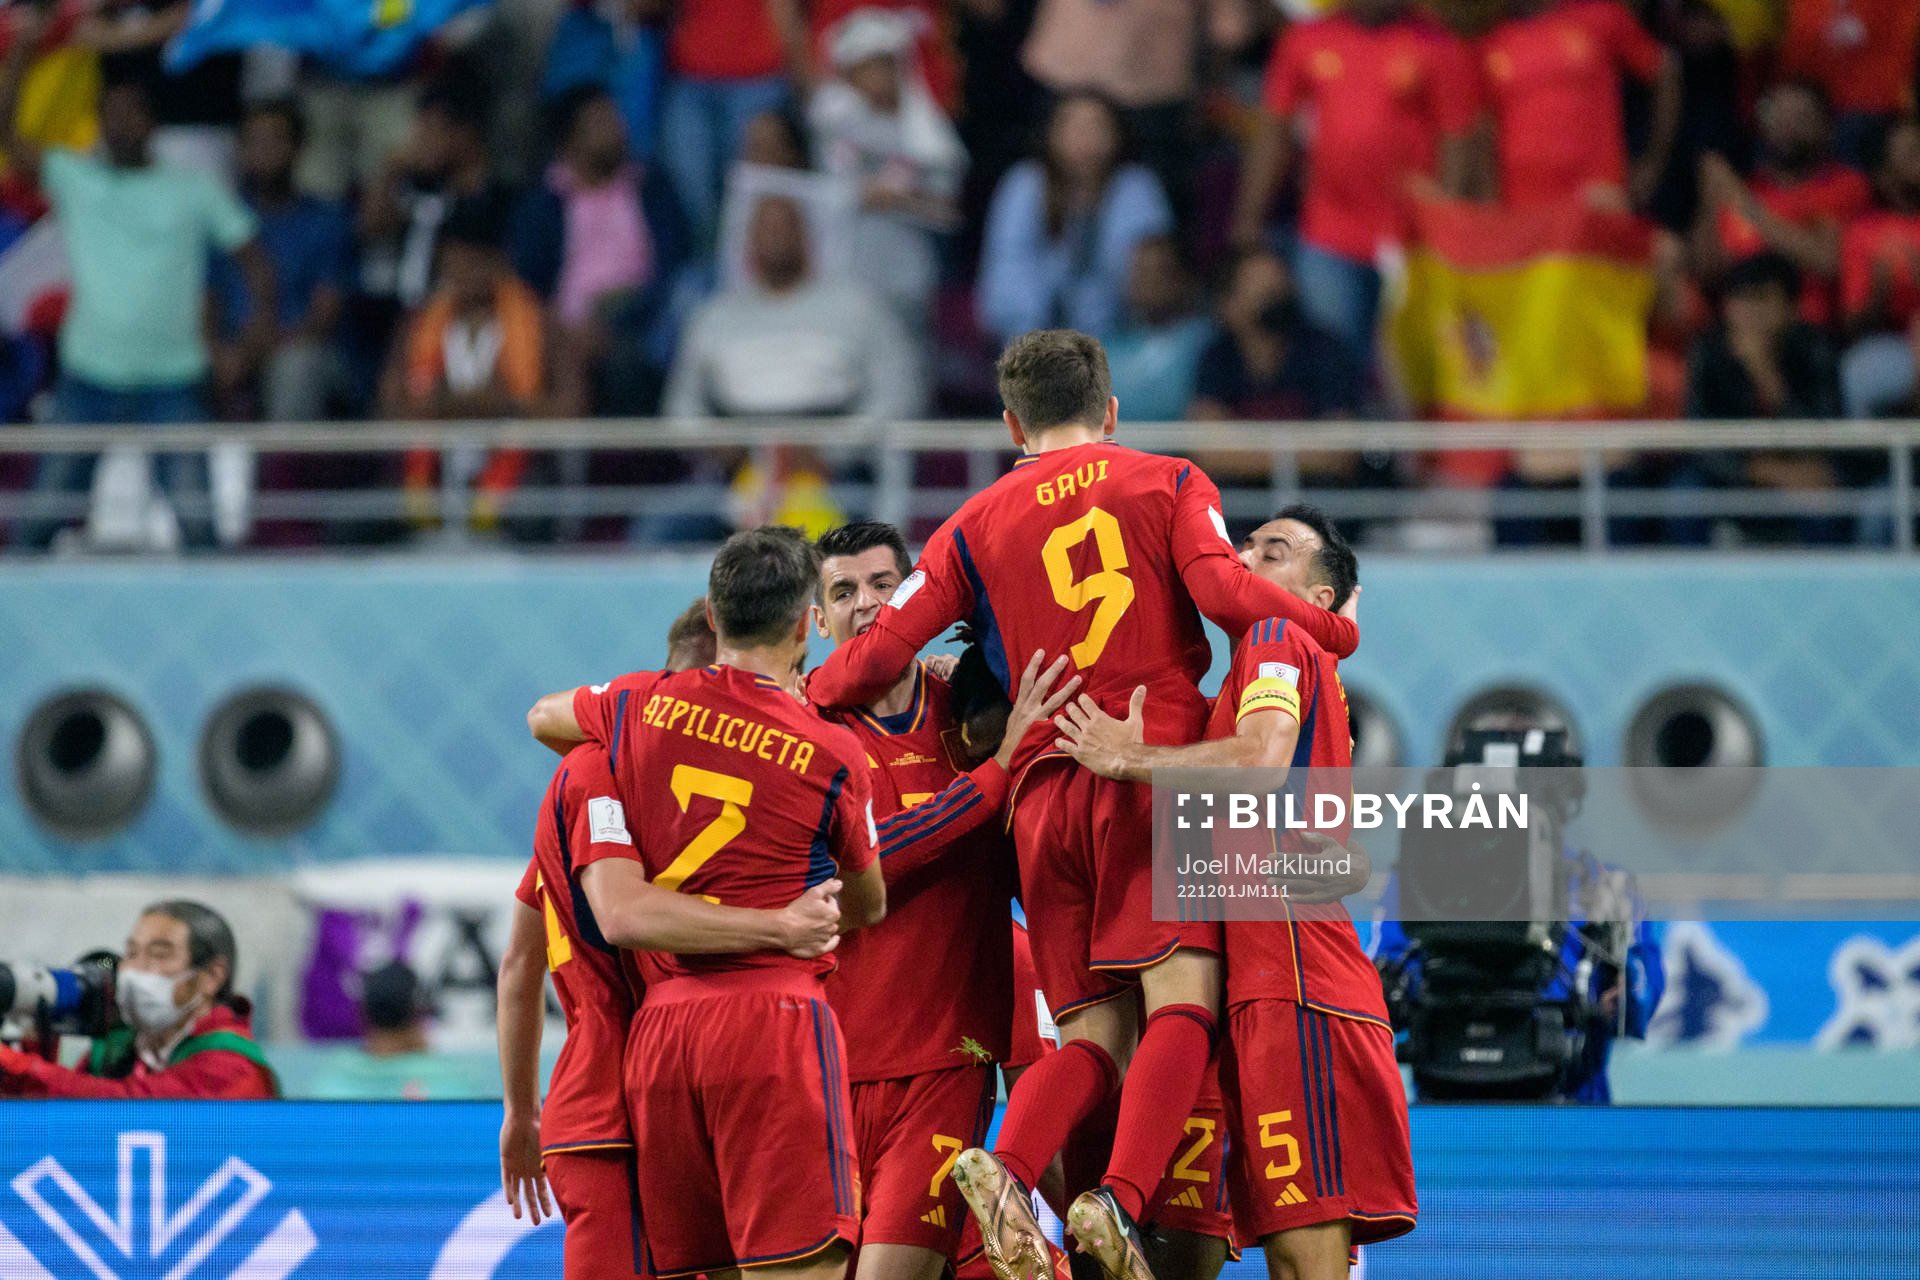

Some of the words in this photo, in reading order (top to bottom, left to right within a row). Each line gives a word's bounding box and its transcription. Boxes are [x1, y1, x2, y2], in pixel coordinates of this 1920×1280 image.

[1036, 460, 1109, 505] GAVI
[1041, 506, 1136, 670] 9
[642, 694, 815, 775] AZPILICUETA
[928, 1134, 963, 1197] 7
[1258, 1109, 1301, 1180] 5
